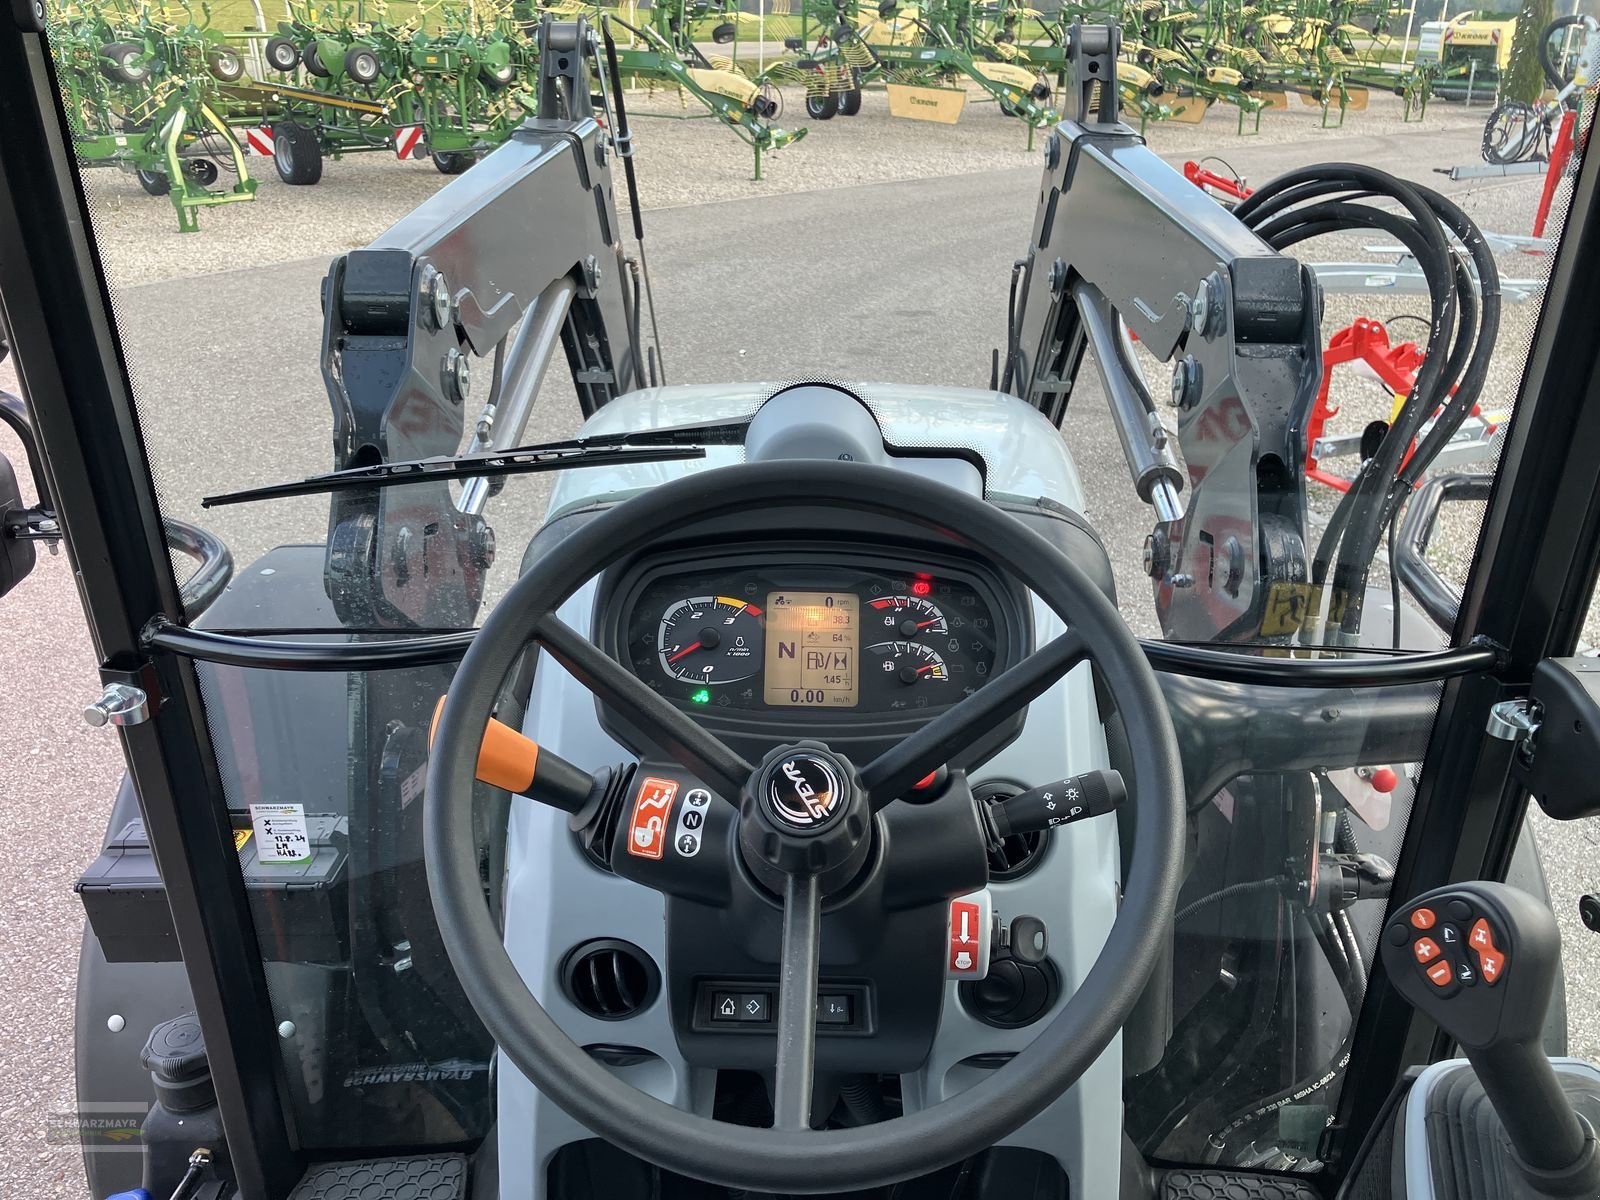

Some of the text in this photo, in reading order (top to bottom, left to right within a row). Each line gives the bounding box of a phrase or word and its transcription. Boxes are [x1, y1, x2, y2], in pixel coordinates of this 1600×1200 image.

[1461, 32, 1488, 40] KRONE
[825, 596, 834, 608] 0
[723, 617, 735, 625] 3
[833, 615, 850, 624] 38.3
[832, 633, 843, 642] 64
[778, 641, 796, 659] N
[702, 665, 714, 673] 0
[790, 689, 825, 703] 0.00
[782, 760, 830, 819] STEYR
[686, 814, 698, 826] N
